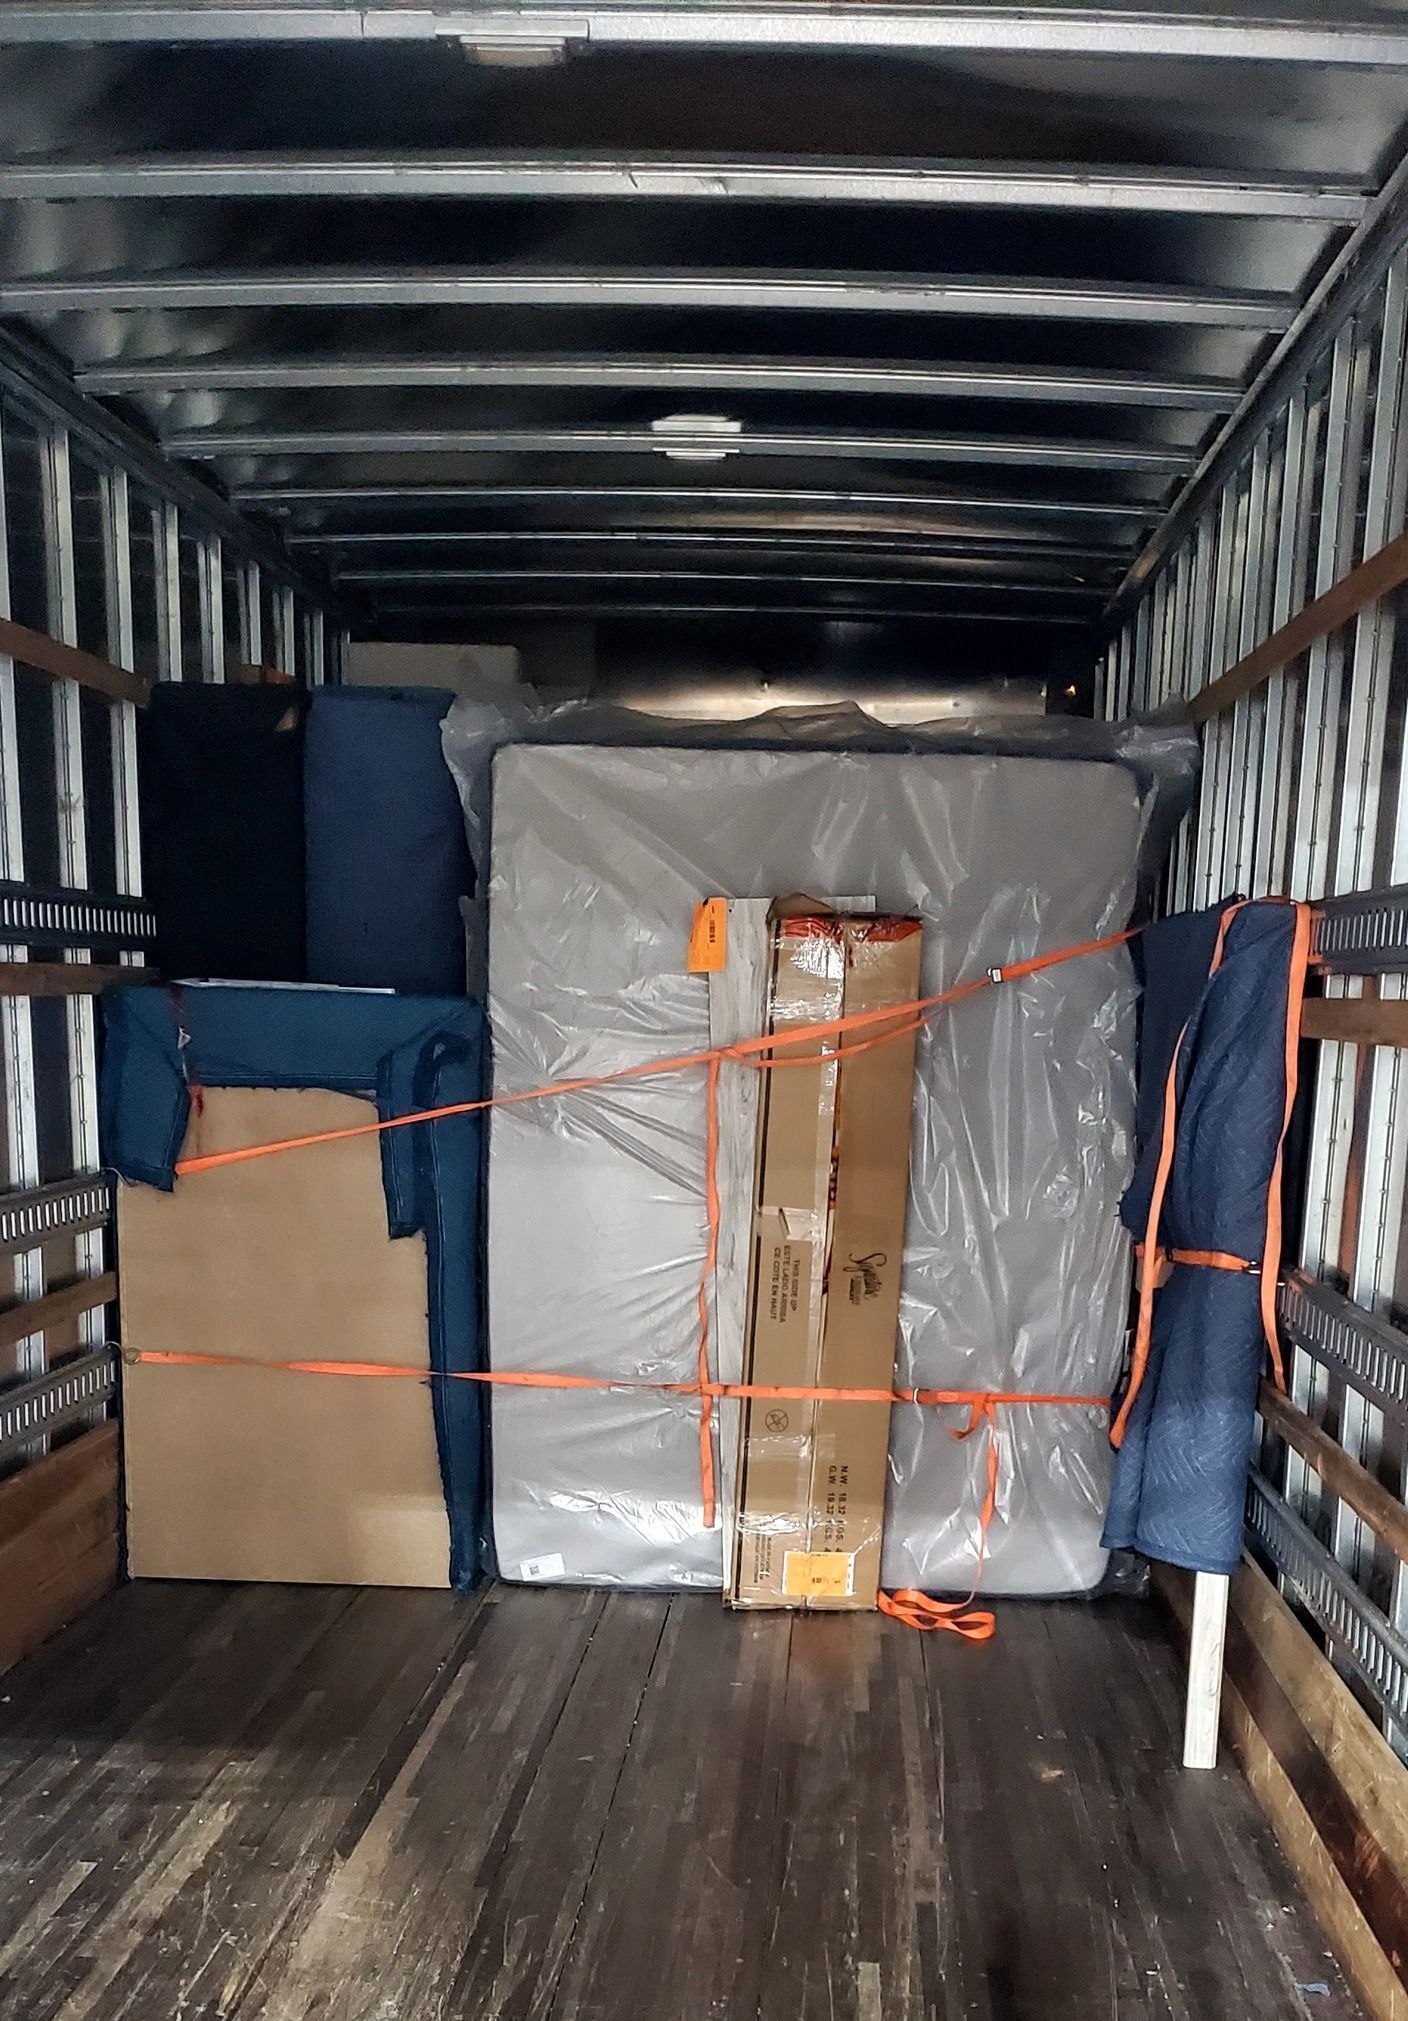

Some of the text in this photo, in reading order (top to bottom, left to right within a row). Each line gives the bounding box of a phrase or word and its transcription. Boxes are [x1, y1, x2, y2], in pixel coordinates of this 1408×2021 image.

[774, 1247, 781, 1258] CE
[783, 1245, 791, 1266] ESTE
[792, 1259, 800, 1277] THIS
[771, 1285, 779, 1296] EN
[790, 1300, 797, 1311] UP
[840, 1465, 848, 1487] N.W.
